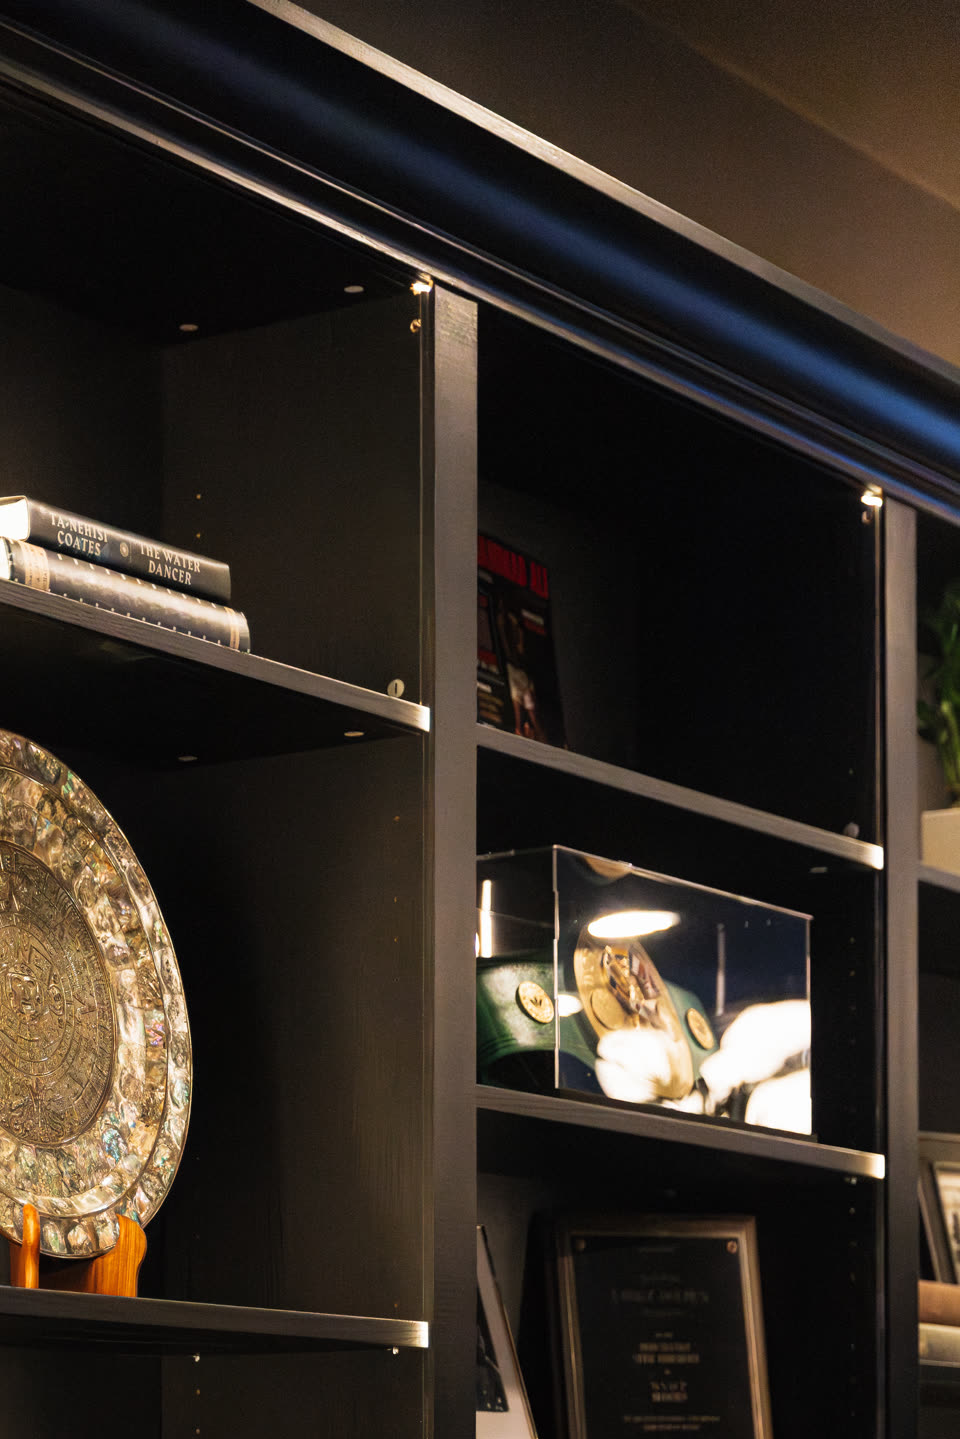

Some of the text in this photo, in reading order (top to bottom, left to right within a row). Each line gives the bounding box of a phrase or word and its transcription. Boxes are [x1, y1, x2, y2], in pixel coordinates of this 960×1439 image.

[57, 530, 102, 557] COATES
[139, 542, 201, 574] THE WATER
[149, 560, 193, 586] DANCER
